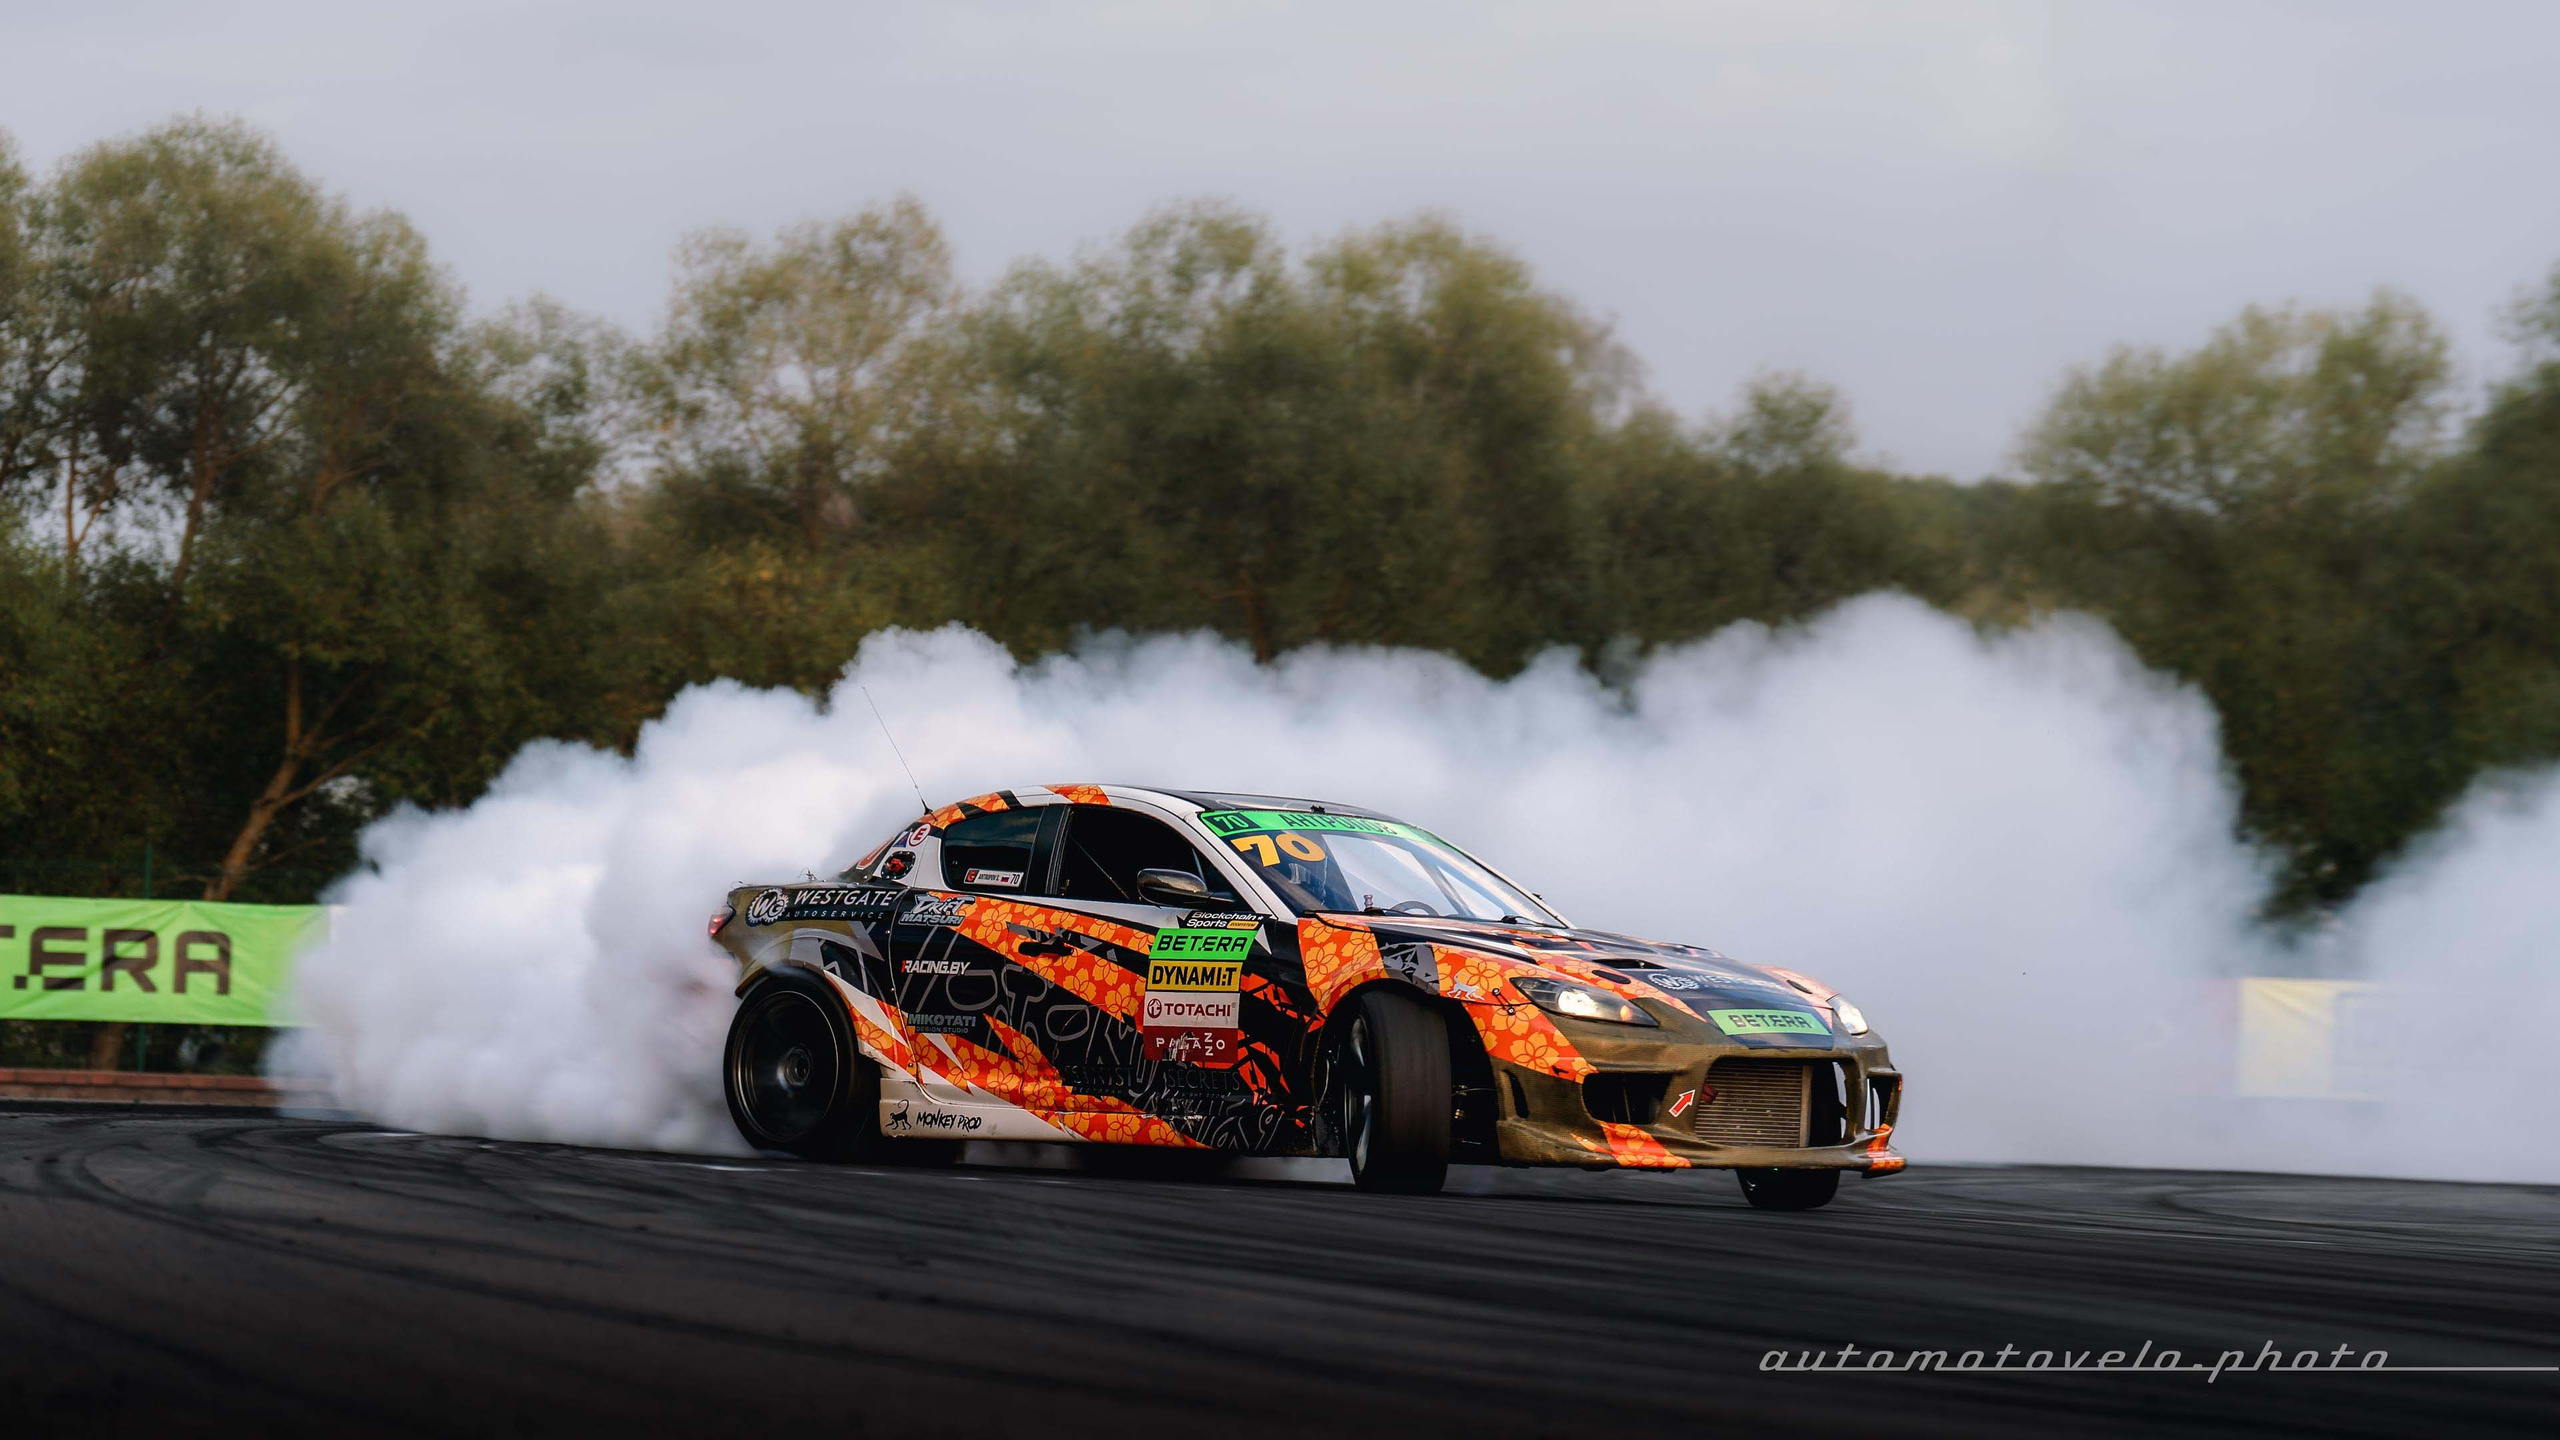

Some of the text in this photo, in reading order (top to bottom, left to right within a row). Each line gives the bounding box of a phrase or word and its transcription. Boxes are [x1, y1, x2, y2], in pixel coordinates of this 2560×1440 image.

[1213, 813, 1249, 830] 70
[913, 827, 928, 841] E
[1230, 833, 1326, 867] 70
[1010, 873, 1021, 885] 70
[794, 889, 898, 907] WESTGATE
[785, 909, 884, 919] AUTOSERVICE
[901, 913, 965, 926] MATSURI
[1191, 911, 1257, 921] Blockchain
[1186, 918, 1228, 929] Sports
[907, 1014, 977, 1027] MIKOTATI
[942, 1026, 969, 1034] STUDIO
[1168, 1069, 1241, 1091] SECRETS
[916, 1109, 982, 1132] MONKEY PROD
